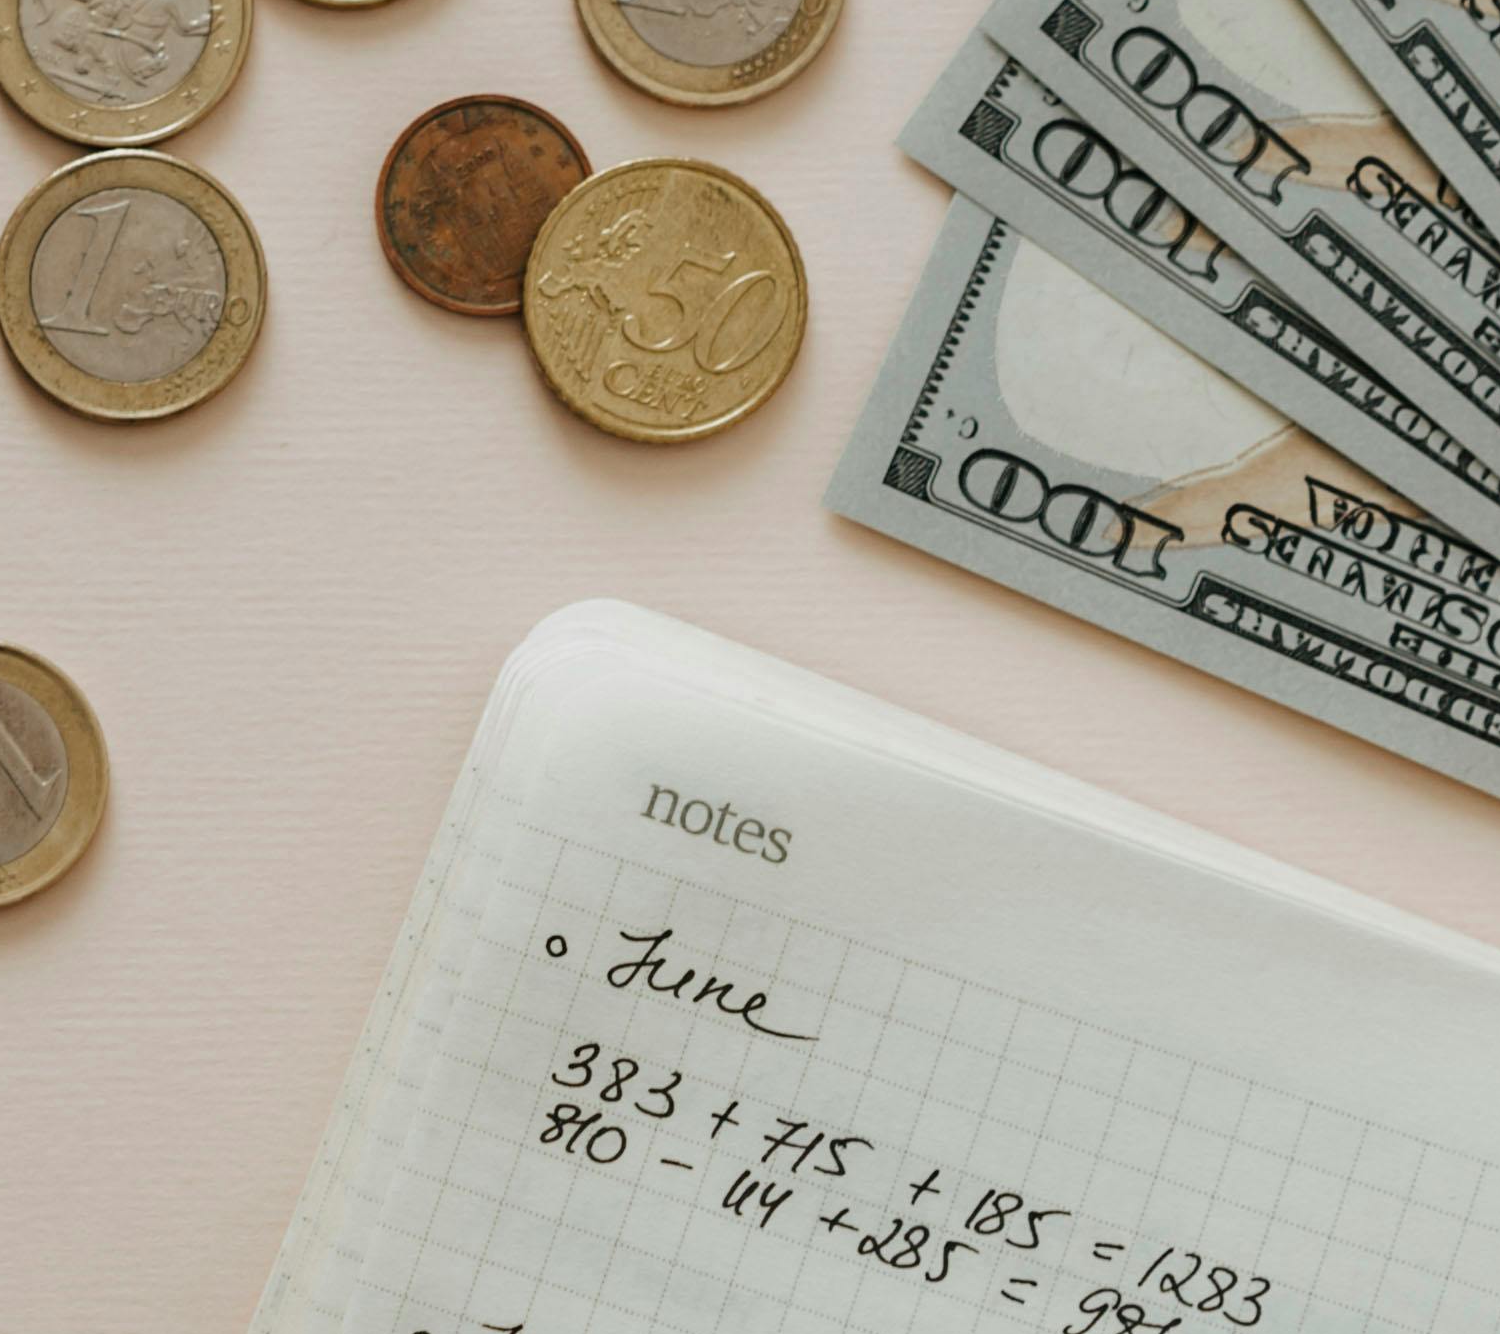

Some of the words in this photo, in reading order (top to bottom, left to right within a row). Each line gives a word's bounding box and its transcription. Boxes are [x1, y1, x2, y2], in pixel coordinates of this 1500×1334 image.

[622, 244, 788, 375] 50
[644, 786, 792, 863] notes
[606, 928, 813, 1041] June
[539, 1103, 627, 1164] 810
[857, 1218, 979, 1283] 285
[551, 1042, 682, 1119] 383
[760, 1117, 874, 1177] 715
[964, 1188, 1072, 1250] 185
[1137, 1247, 1271, 1327] 1283
